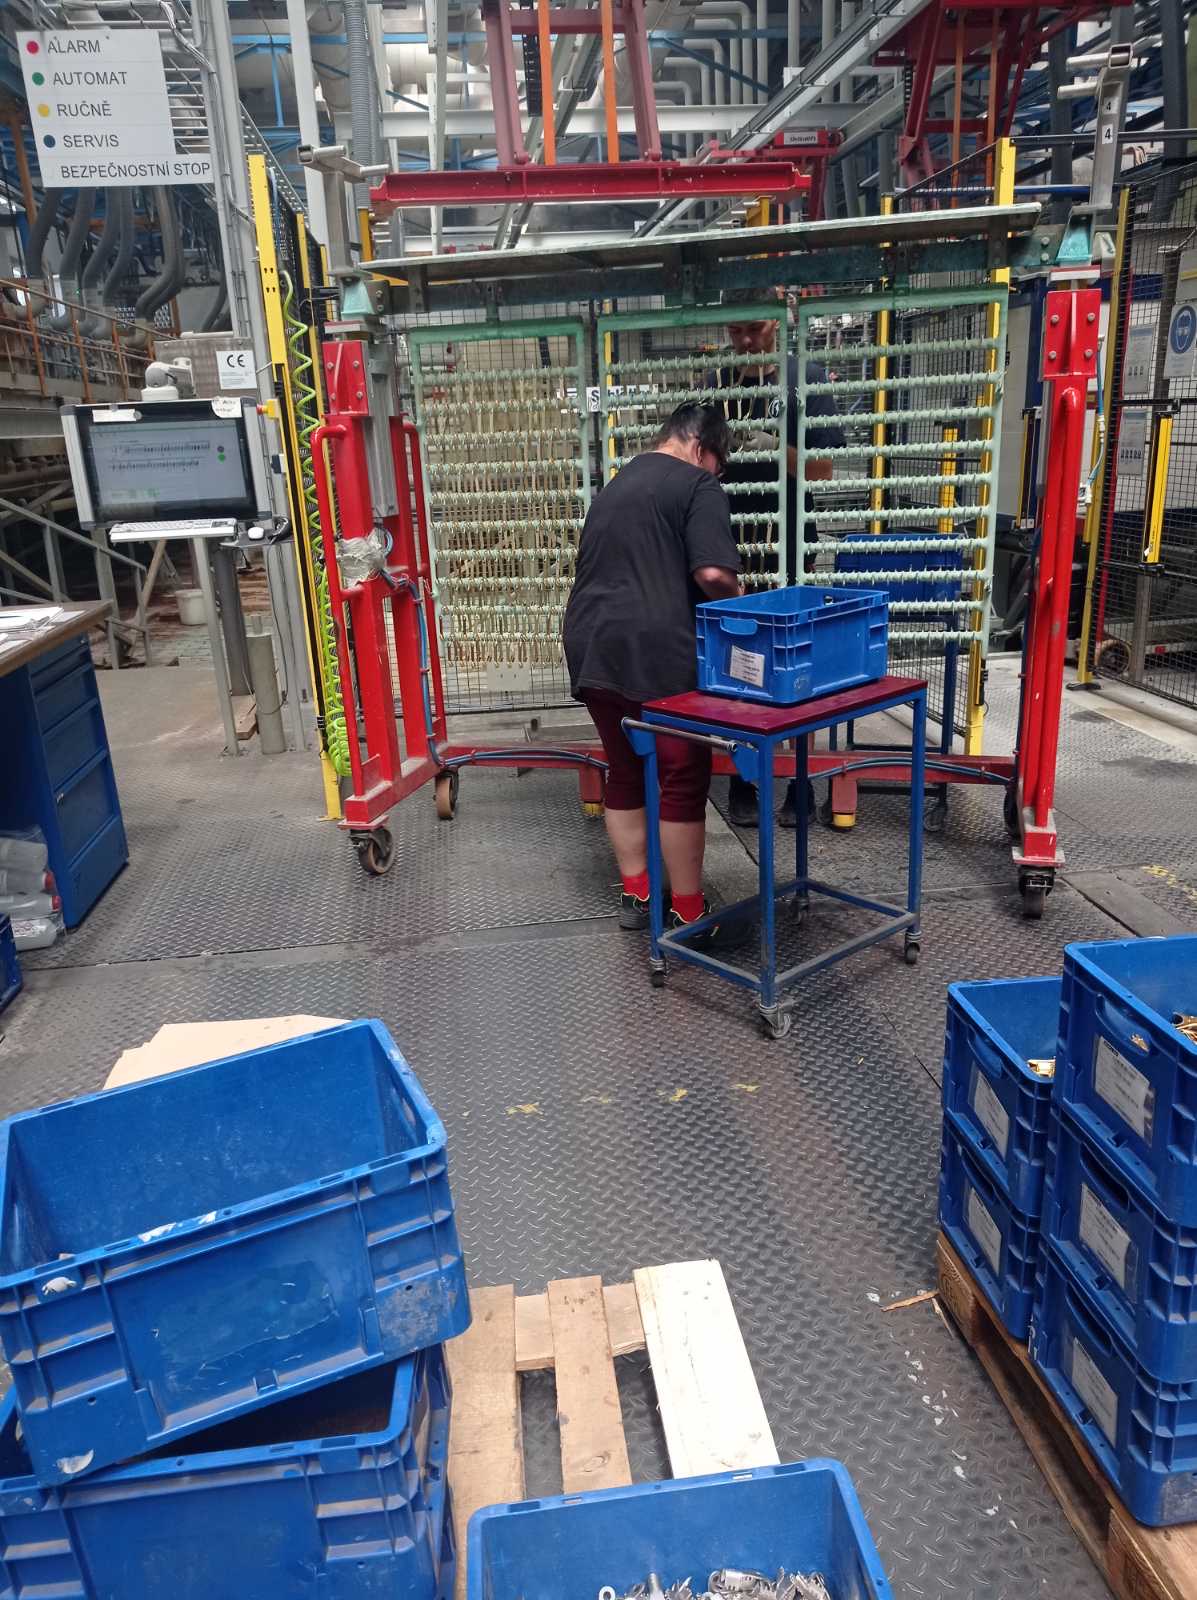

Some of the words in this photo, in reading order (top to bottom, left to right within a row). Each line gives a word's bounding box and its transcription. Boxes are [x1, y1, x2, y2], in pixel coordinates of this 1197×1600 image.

[48, 39, 101, 54] ALARM
[53, 71, 127, 86] AUTOMAT
[57, 101, 112, 117] RUČNĚ
[1105, 101, 1112, 111] 4
[1104, 127, 1112, 140] 4
[63, 134, 119, 148] SERVIS
[61, 161, 170, 178] BEZPEČNOSTNÍ
[174, 163, 210, 176] STOP
[226, 354, 246, 368] CE
